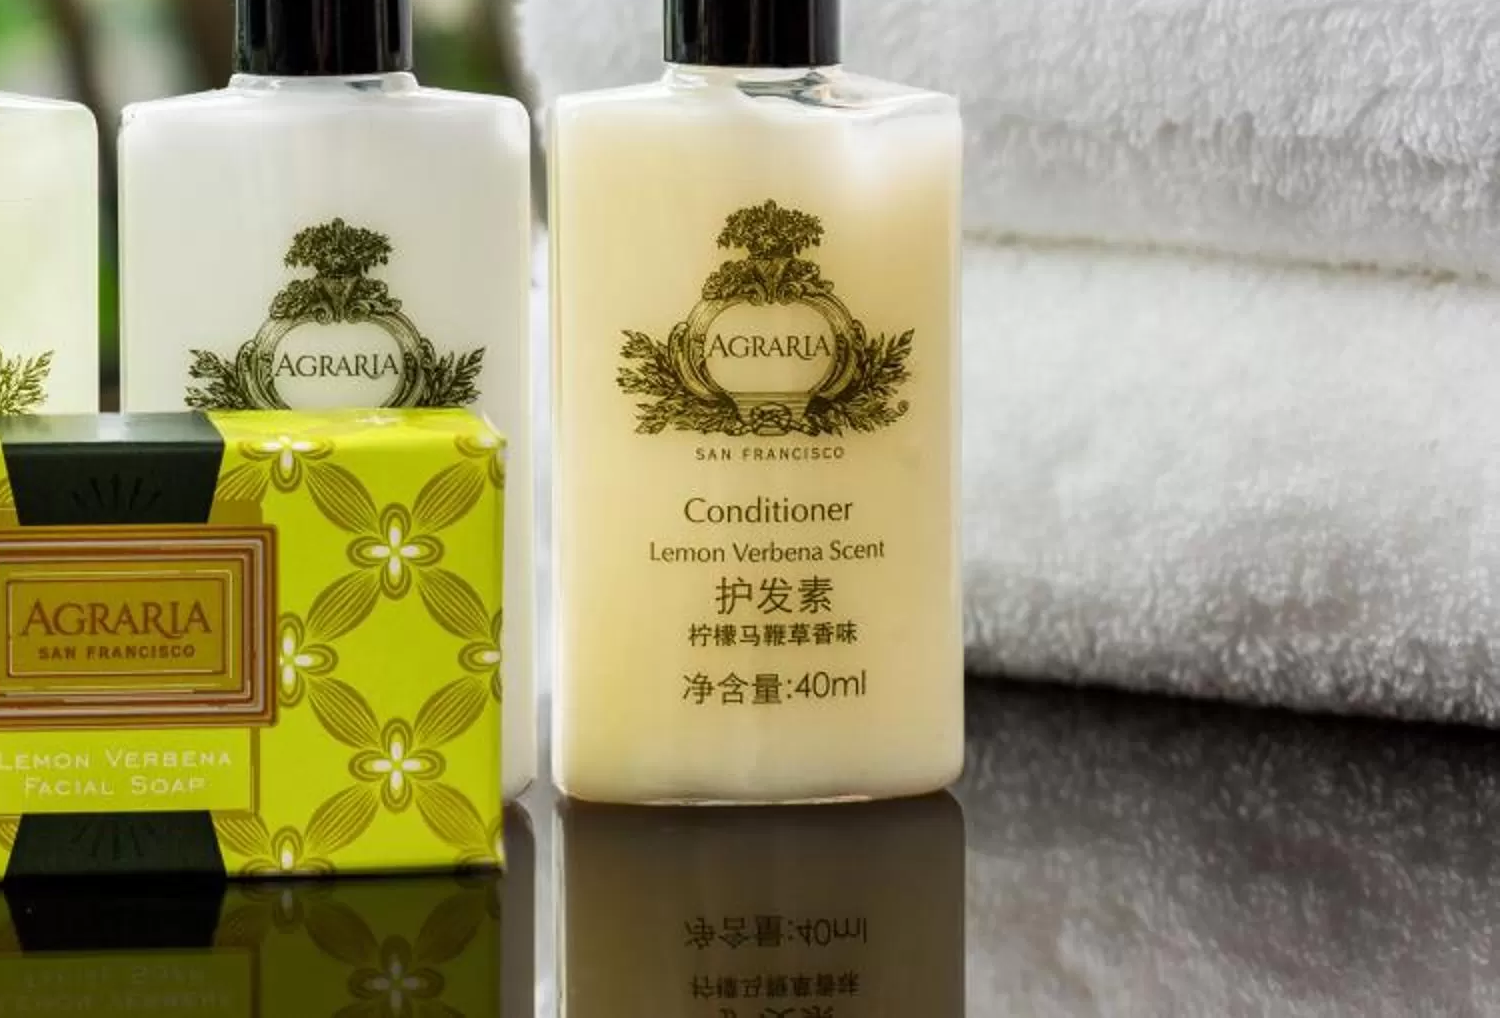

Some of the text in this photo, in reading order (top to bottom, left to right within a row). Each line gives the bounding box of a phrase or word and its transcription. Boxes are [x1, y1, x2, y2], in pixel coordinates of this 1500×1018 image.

[706, 333, 833, 361] AGRARIA
[275, 353, 399, 380] AGRARIA
[695, 445, 846, 461] SAN FRANCISCO
[683, 496, 853, 524] Conditioner
[649, 539, 885, 563] Lemon Verbena Scent
[715, 575, 834, 615] 护发素
[20, 598, 212, 639] AGRARIA
[687, 620, 858, 648] 柠檬马鞭草香味
[38, 644, 196, 661] SAN FRANCISCO
[105, 747, 232, 769] VERBENA
[24, 775, 206, 797] FACIAL SOAP
